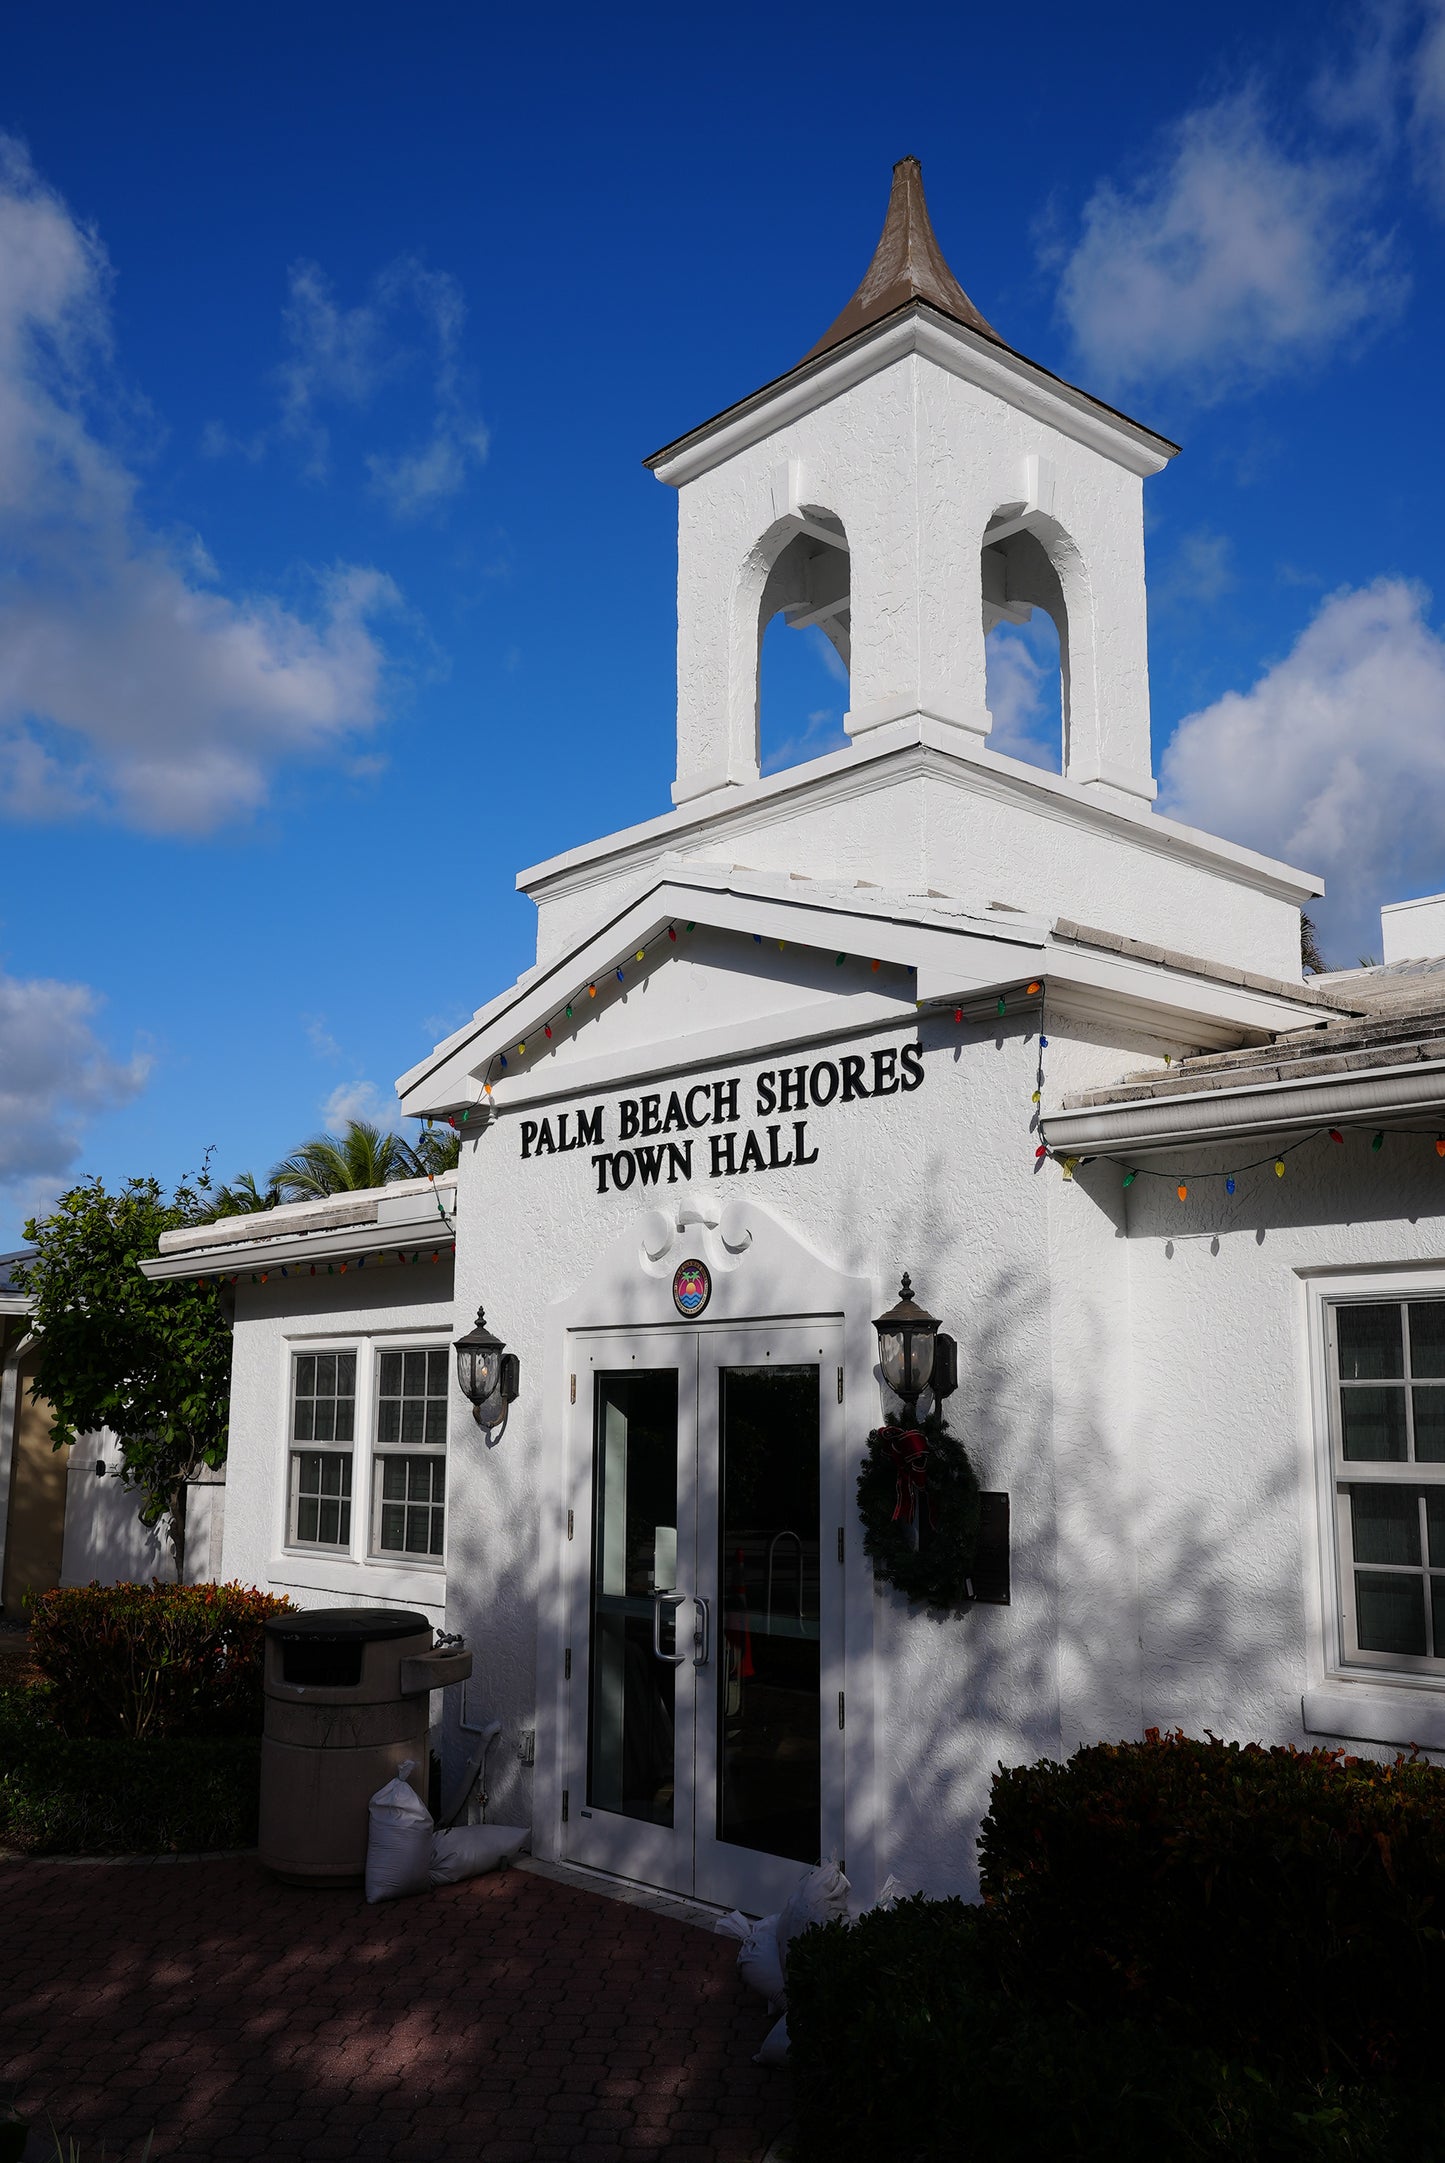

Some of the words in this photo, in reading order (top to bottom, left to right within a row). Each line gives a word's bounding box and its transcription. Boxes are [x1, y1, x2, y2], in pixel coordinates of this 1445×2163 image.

[520, 1106, 605, 1159] PALM
[618, 1079, 740, 1141] BEACH
[757, 1043, 925, 1117] SHORES
[592, 1140, 693, 1194] TOWN
[708, 1121, 819, 1178] HALL
